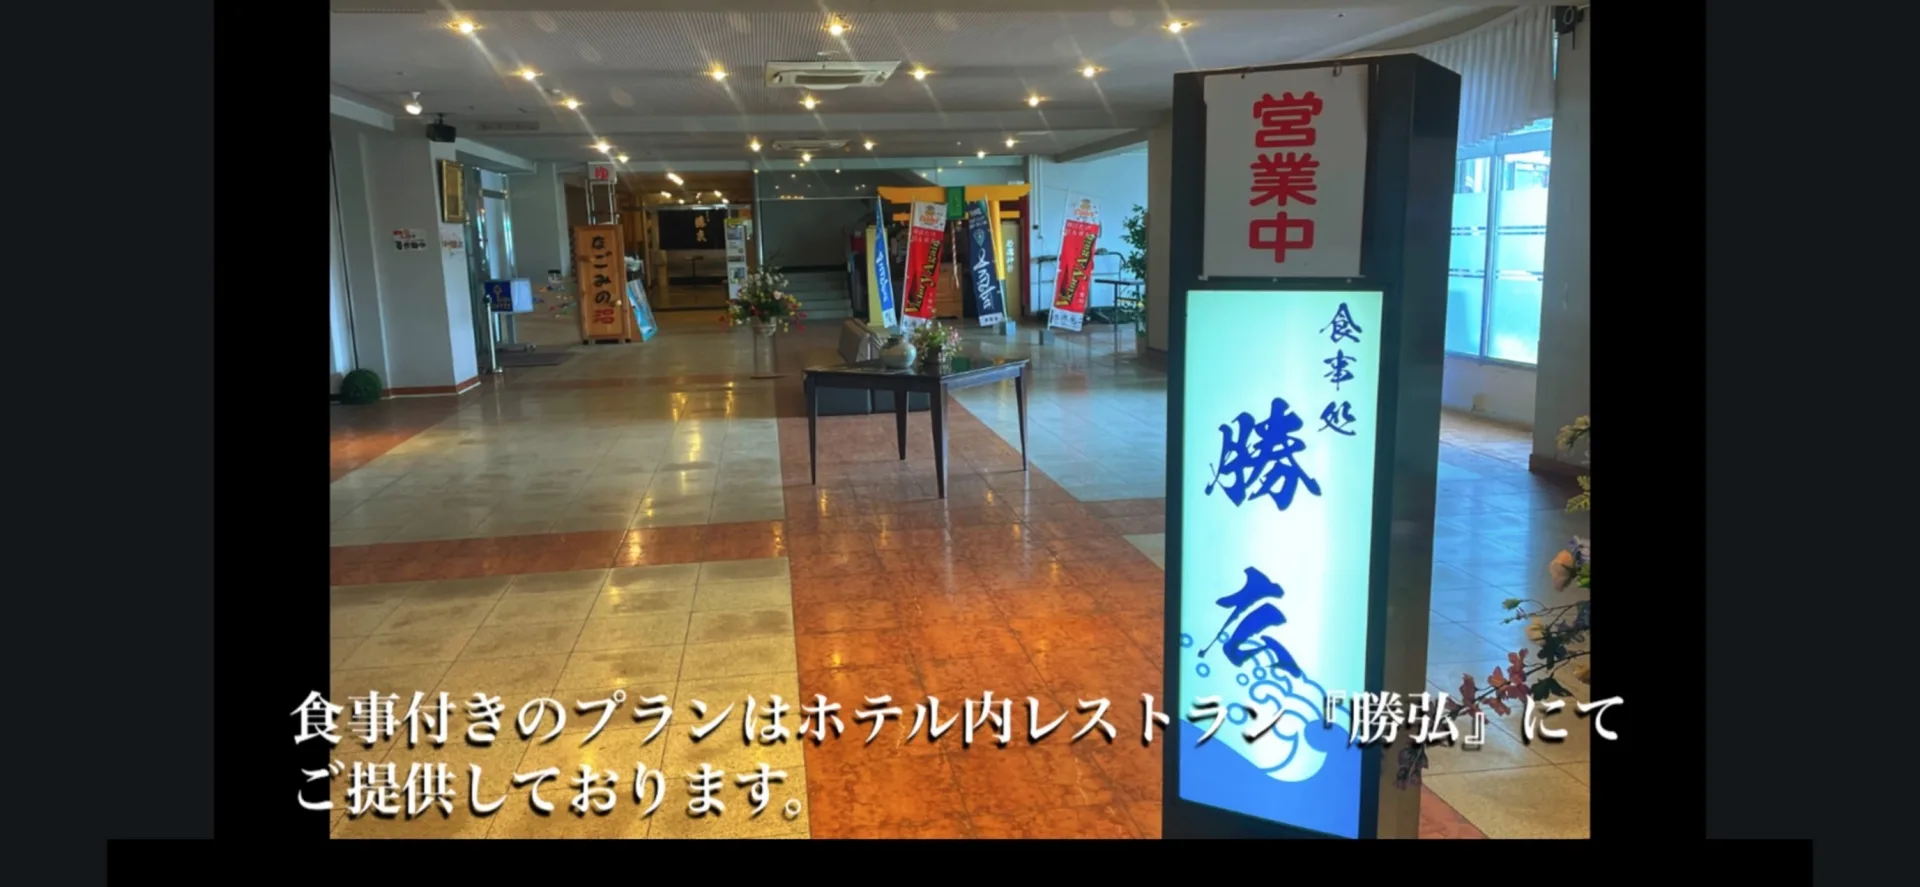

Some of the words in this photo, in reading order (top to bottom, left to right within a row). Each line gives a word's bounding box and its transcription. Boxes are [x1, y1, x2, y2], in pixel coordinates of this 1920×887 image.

[1249, 91, 1323, 263] 営業中
[1318, 302, 1363, 437] 食事処
[1197, 397, 1322, 679] 勝広
